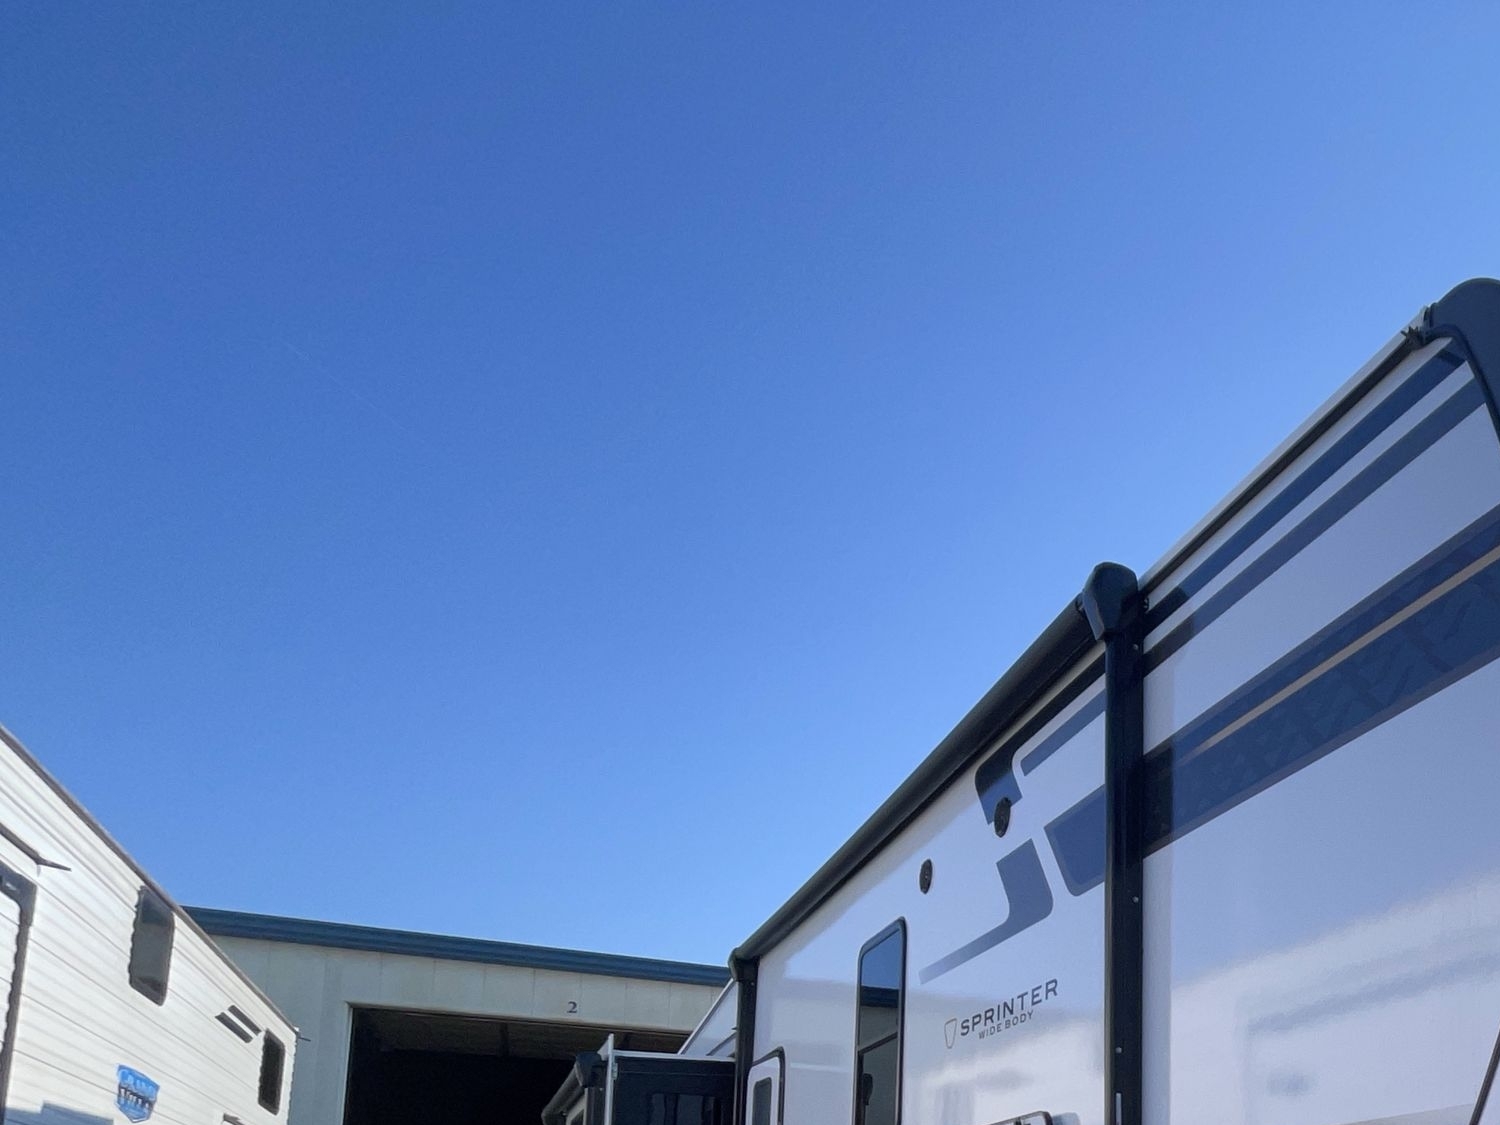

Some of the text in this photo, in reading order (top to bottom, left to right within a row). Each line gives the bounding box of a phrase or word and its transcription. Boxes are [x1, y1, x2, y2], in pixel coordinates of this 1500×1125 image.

[566, 1000, 578, 1014] 2
[960, 978, 1058, 1036] SPRINTER
[979, 1010, 1034, 1040] WIDE BODY
